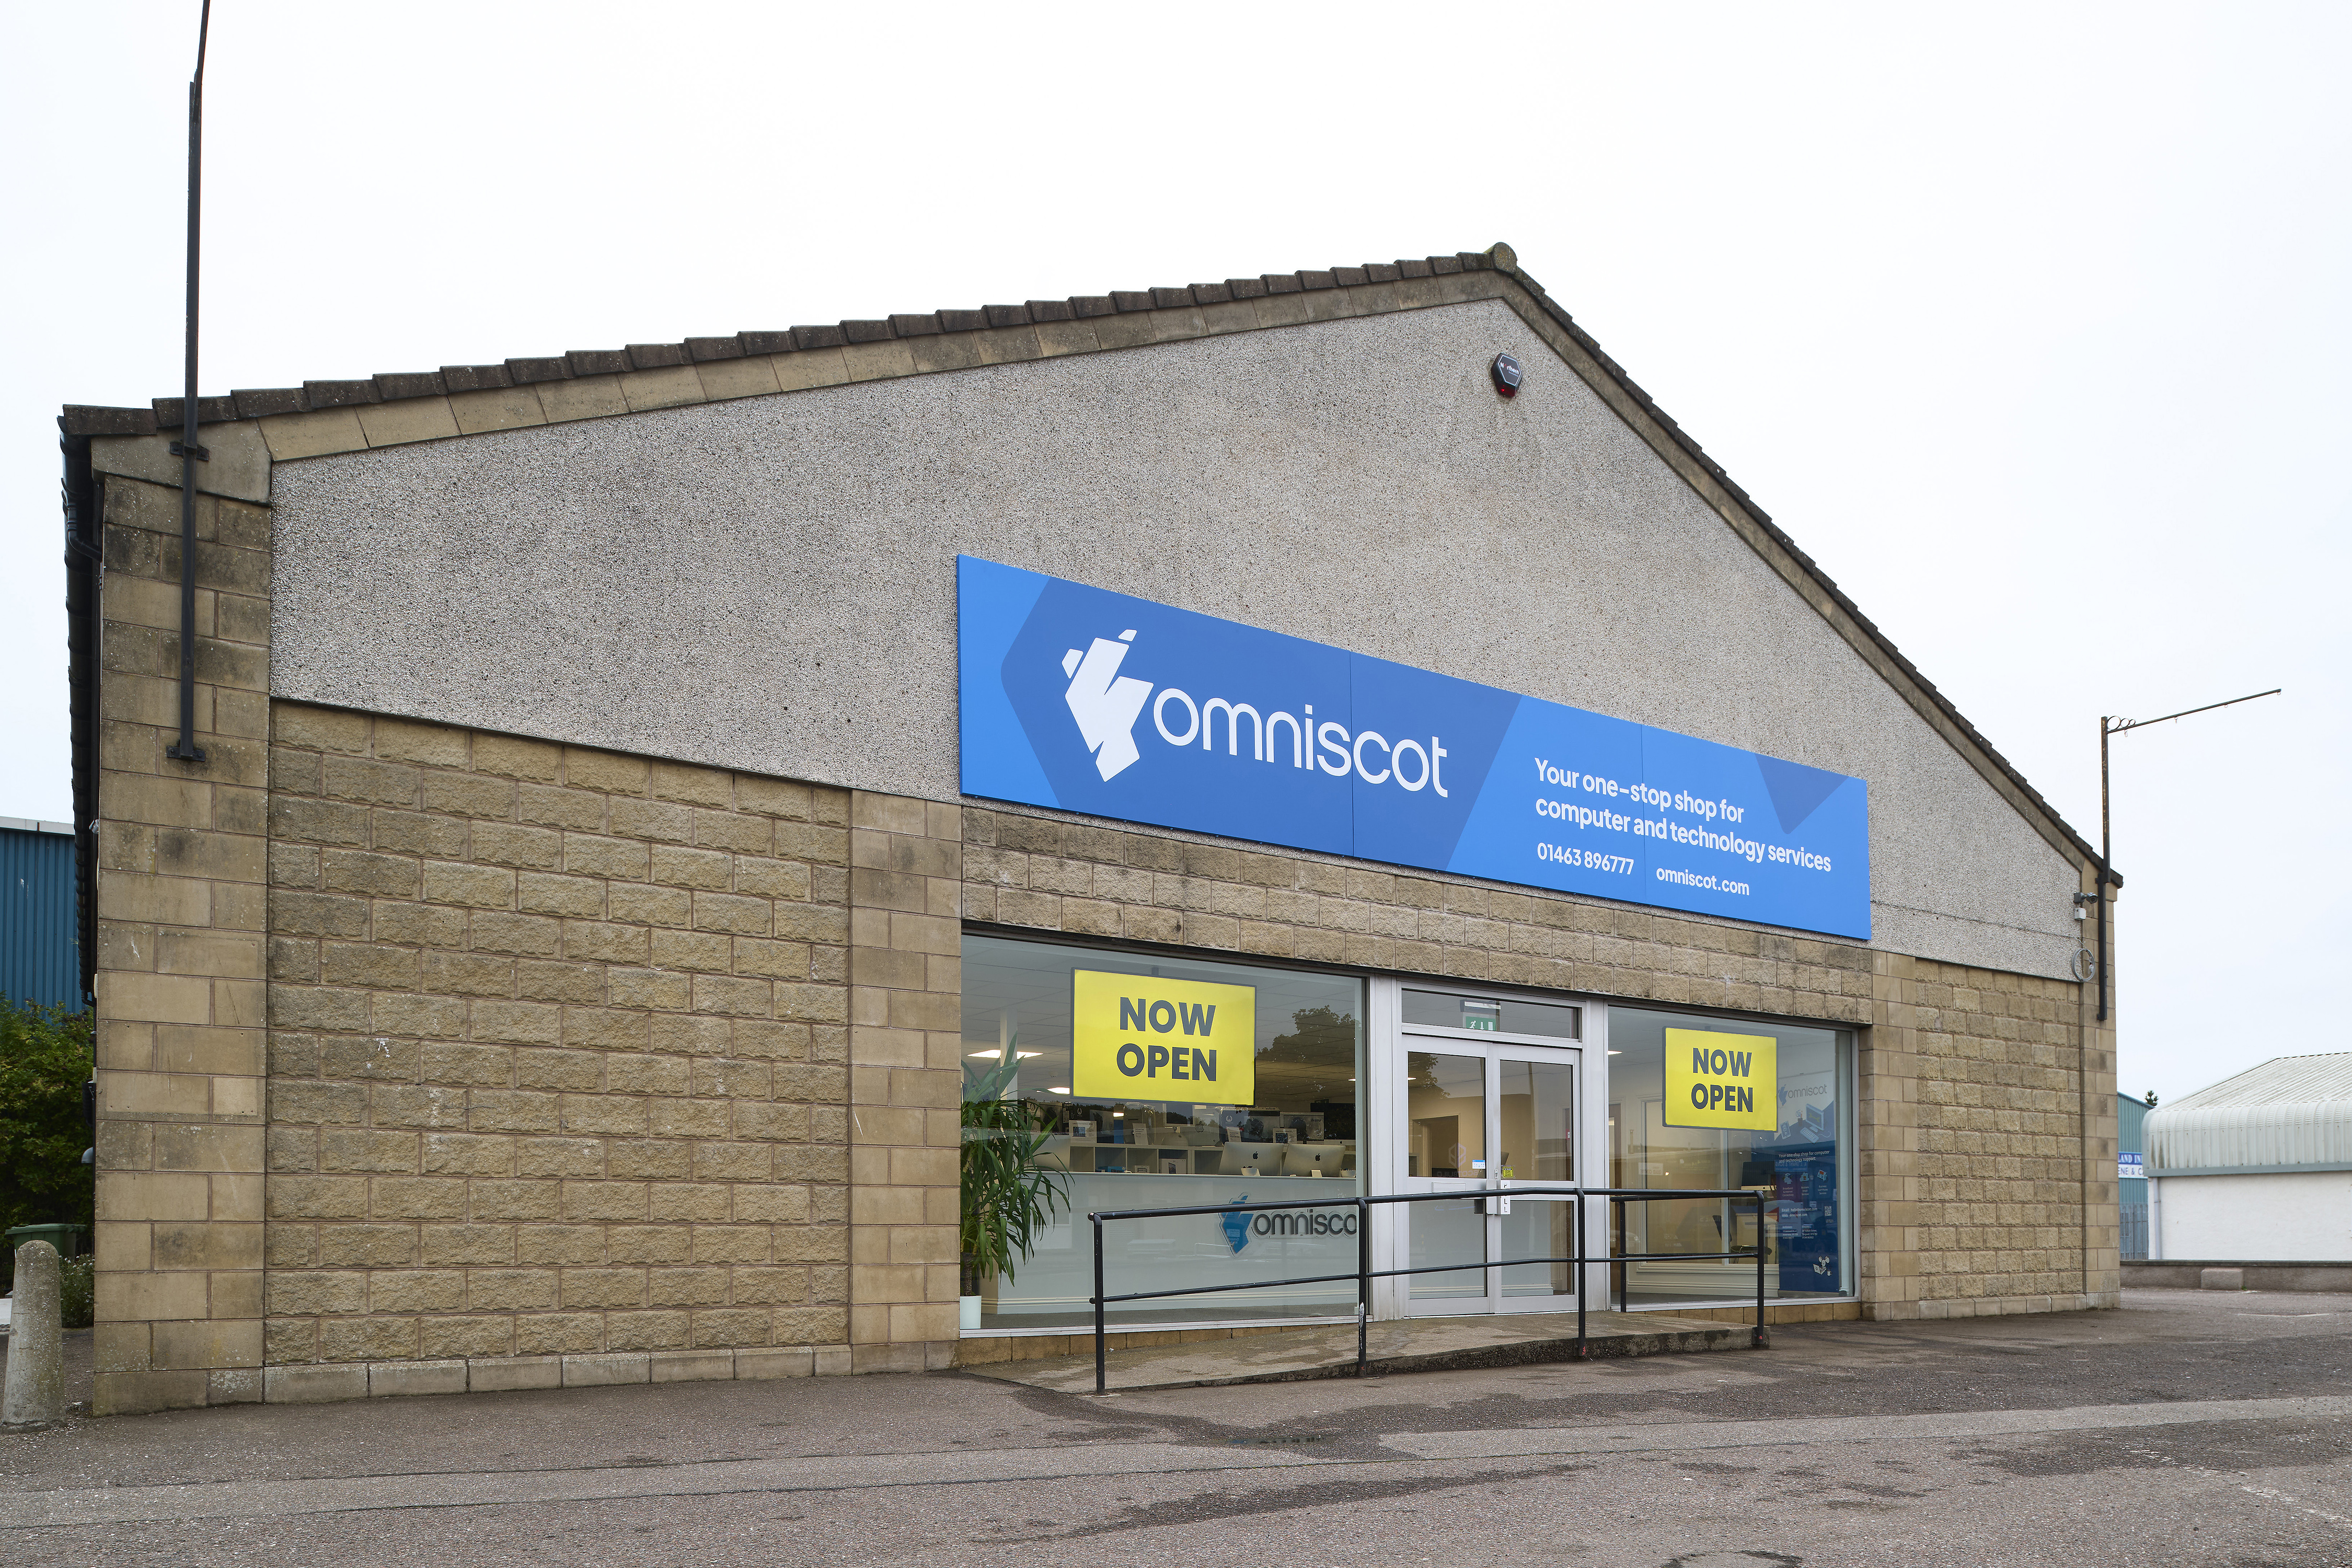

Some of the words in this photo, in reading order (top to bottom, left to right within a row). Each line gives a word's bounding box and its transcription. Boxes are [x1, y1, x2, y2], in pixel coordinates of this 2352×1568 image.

[1153, 688, 1448, 798] omniscot
[1534, 757, 1579, 789] Your
[1582, 774, 1671, 812] one-stop
[1674, 790, 1717, 822] shop
[1719, 799, 1744, 823] for
[1536, 798, 1631, 833] computer
[1633, 817, 1667, 840] and
[1669, 822, 1766, 863] technology
[1768, 845, 1831, 872] services
[1537, 842, 1582, 866] 01463
[1584, 850, 1634, 875] 896777
[1656, 868, 1750, 896] omniscot.com
[1120, 996, 1216, 1037] NOW
[1116, 1043, 1217, 1081] OPEN
[1693, 1047, 1752, 1077] NOW
[1691, 1083, 1753, 1113] OPEN
[1788, 1083, 1827, 1099] omniscot
[2134, 1154, 2142, 1163] IN
